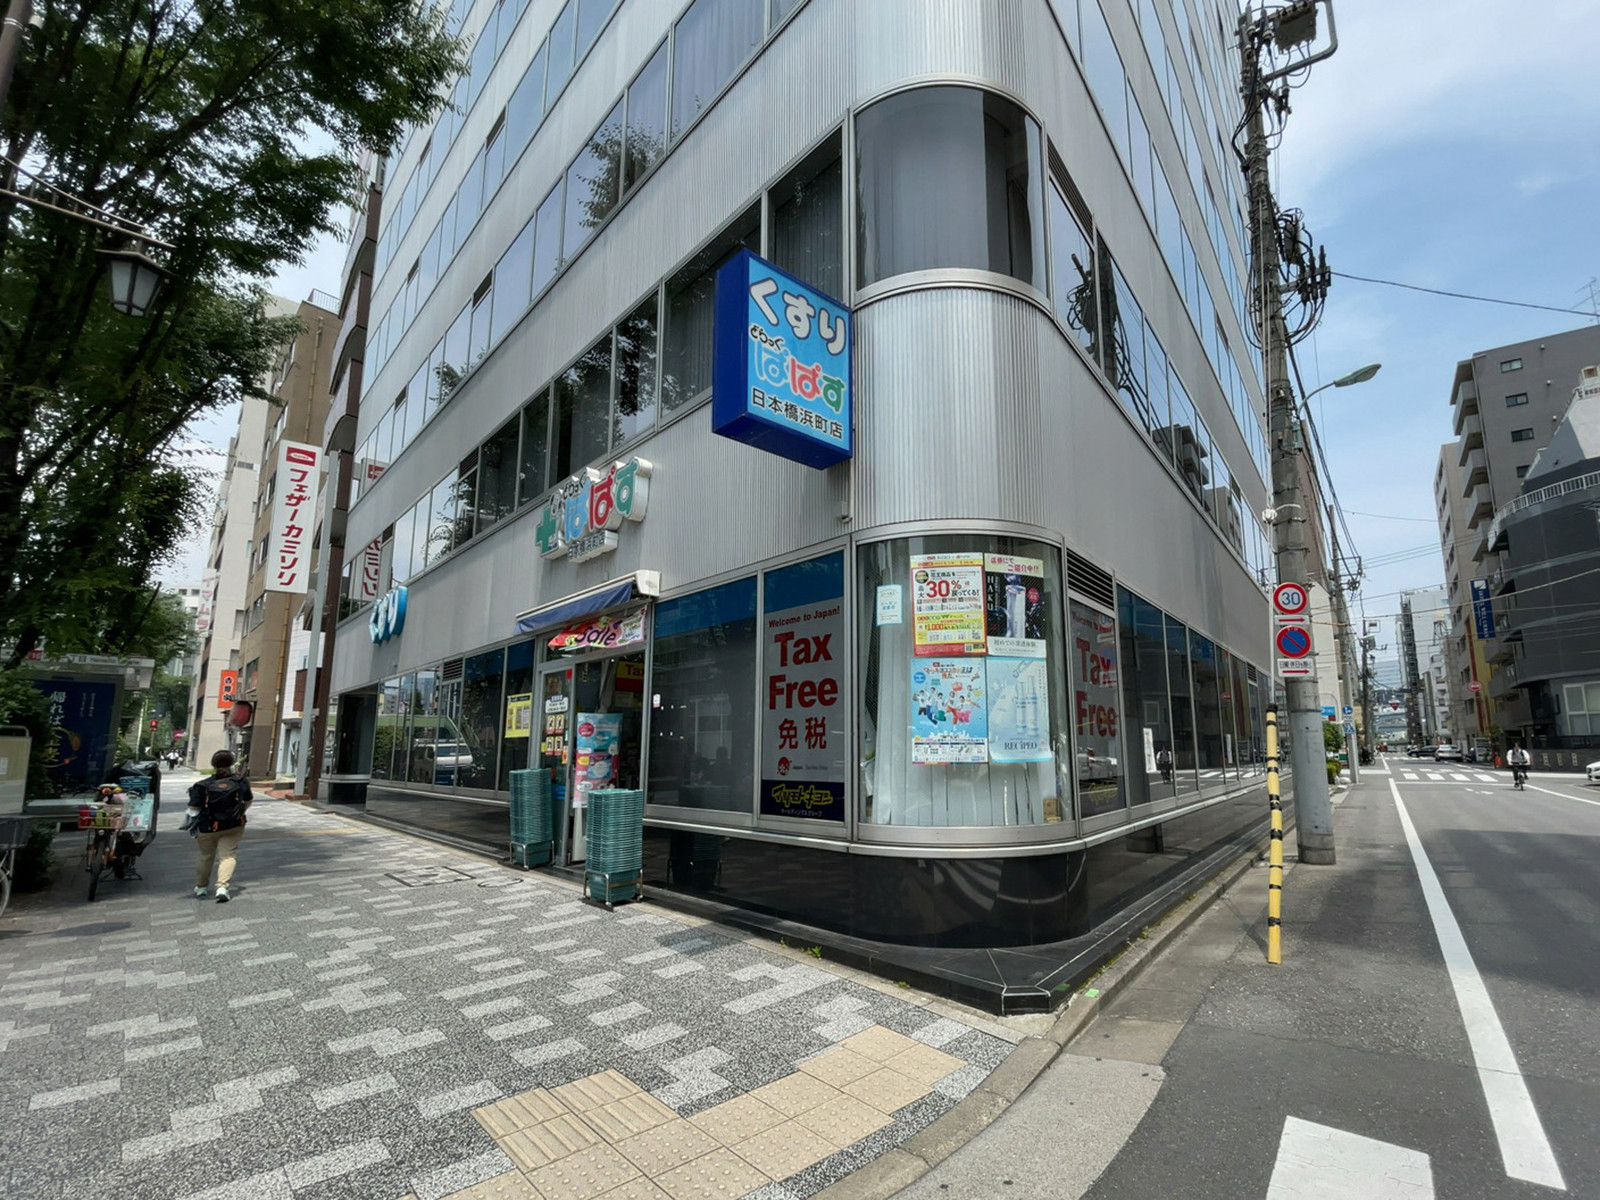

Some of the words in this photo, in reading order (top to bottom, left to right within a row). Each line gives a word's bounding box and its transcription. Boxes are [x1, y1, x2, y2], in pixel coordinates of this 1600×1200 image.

[750, 277, 846, 355] くすり
[754, 343, 846, 413] ぱぱす
[752, 387, 843, 440] 日本橋浜町店
[277, 467, 311, 586] フェザーカミソリ
[769, 616, 801, 628] Welcome
[803, 613, 812, 621] to
[814, 605, 840, 619] Japan!
[1281, 591, 1301, 606] 30
[774, 631, 833, 667] Tax
[769, 674, 838, 710] Free
[779, 716, 827, 750] 免税
[1076, 690, 1116, 737] Free
